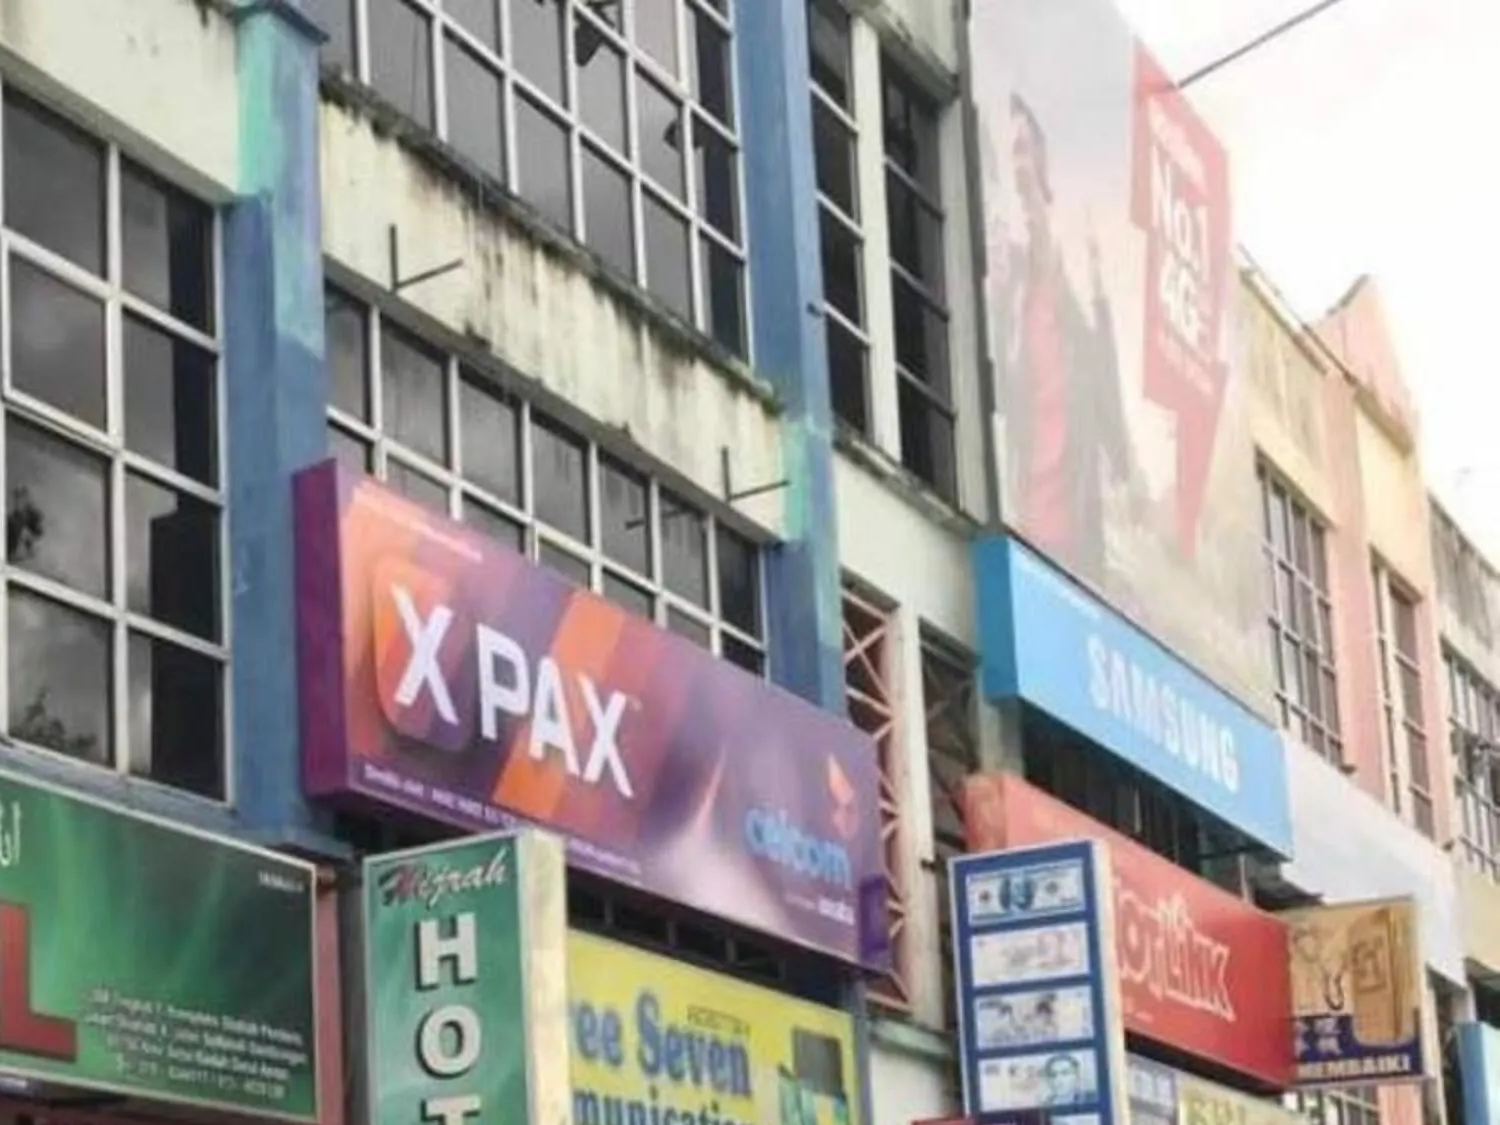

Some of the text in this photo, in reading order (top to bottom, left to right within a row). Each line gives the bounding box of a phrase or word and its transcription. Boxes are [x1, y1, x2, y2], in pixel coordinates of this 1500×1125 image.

[1085, 634, 1240, 796] SAMSUNG
[571, 990, 754, 1099] ee Seven
